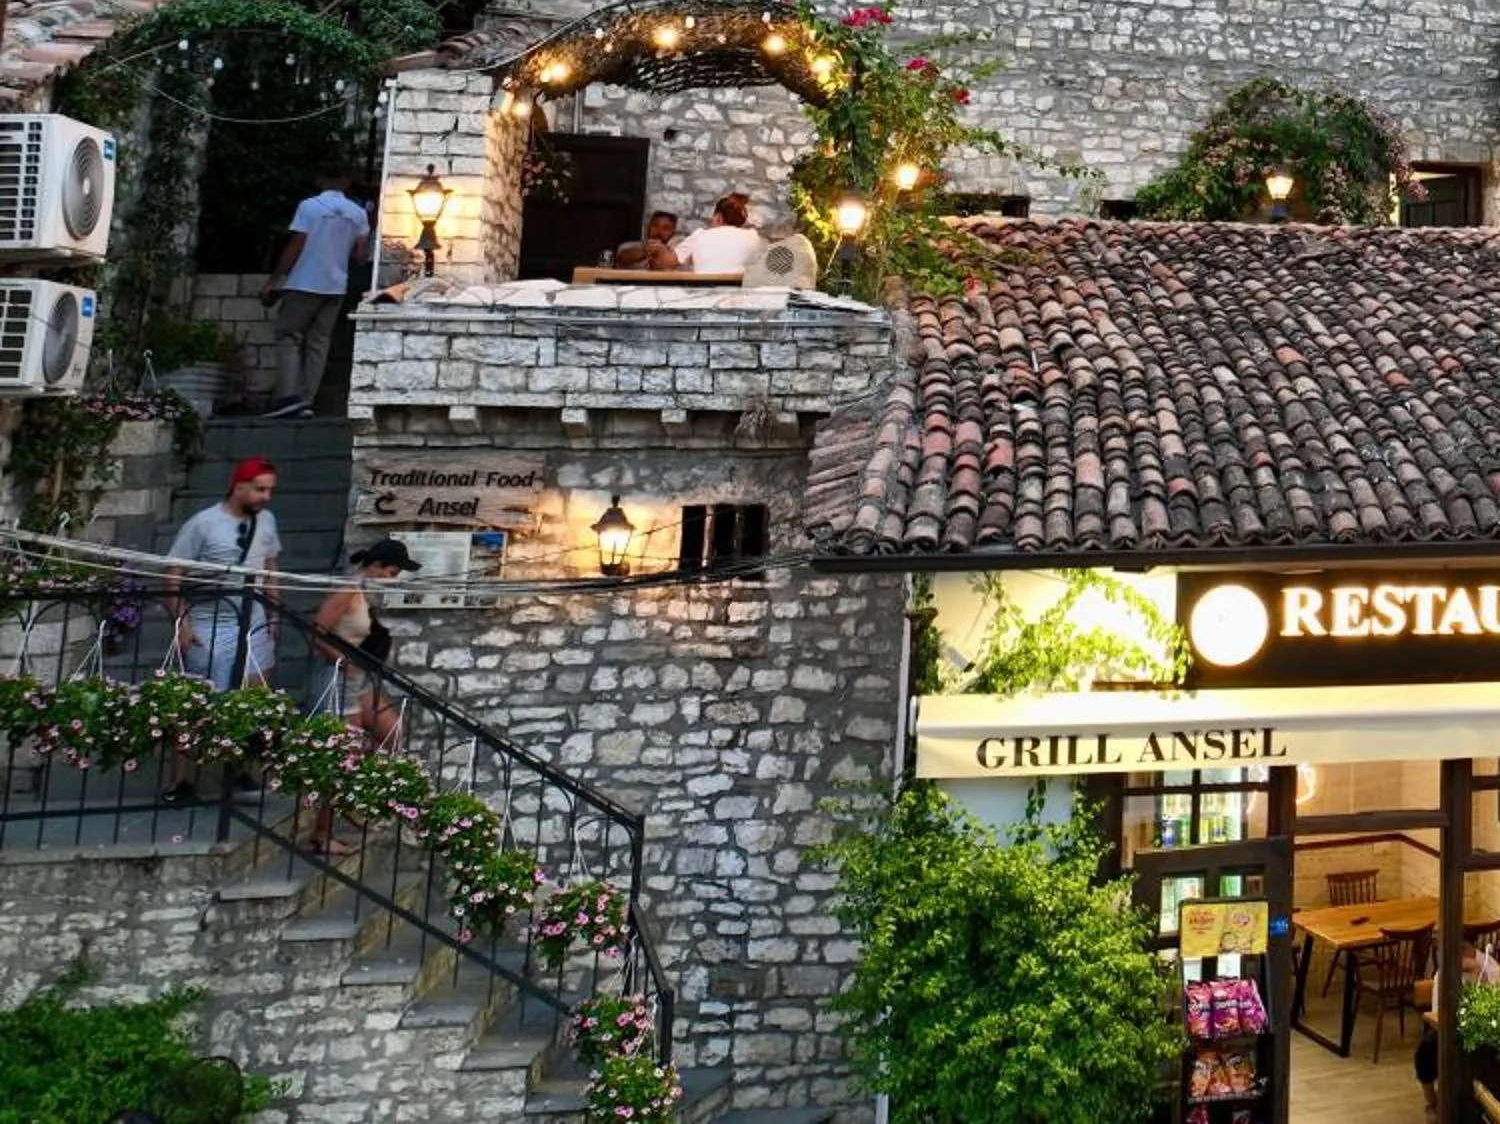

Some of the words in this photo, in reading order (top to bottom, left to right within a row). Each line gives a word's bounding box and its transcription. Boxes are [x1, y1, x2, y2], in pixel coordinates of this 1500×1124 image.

[370, 468, 477, 487] Traditional
[485, 470, 536, 487] Food
[418, 497, 480, 516] Ansel
[976, 733, 1122, 769] GRILL
[1136, 727, 1288, 762] ANSEL
